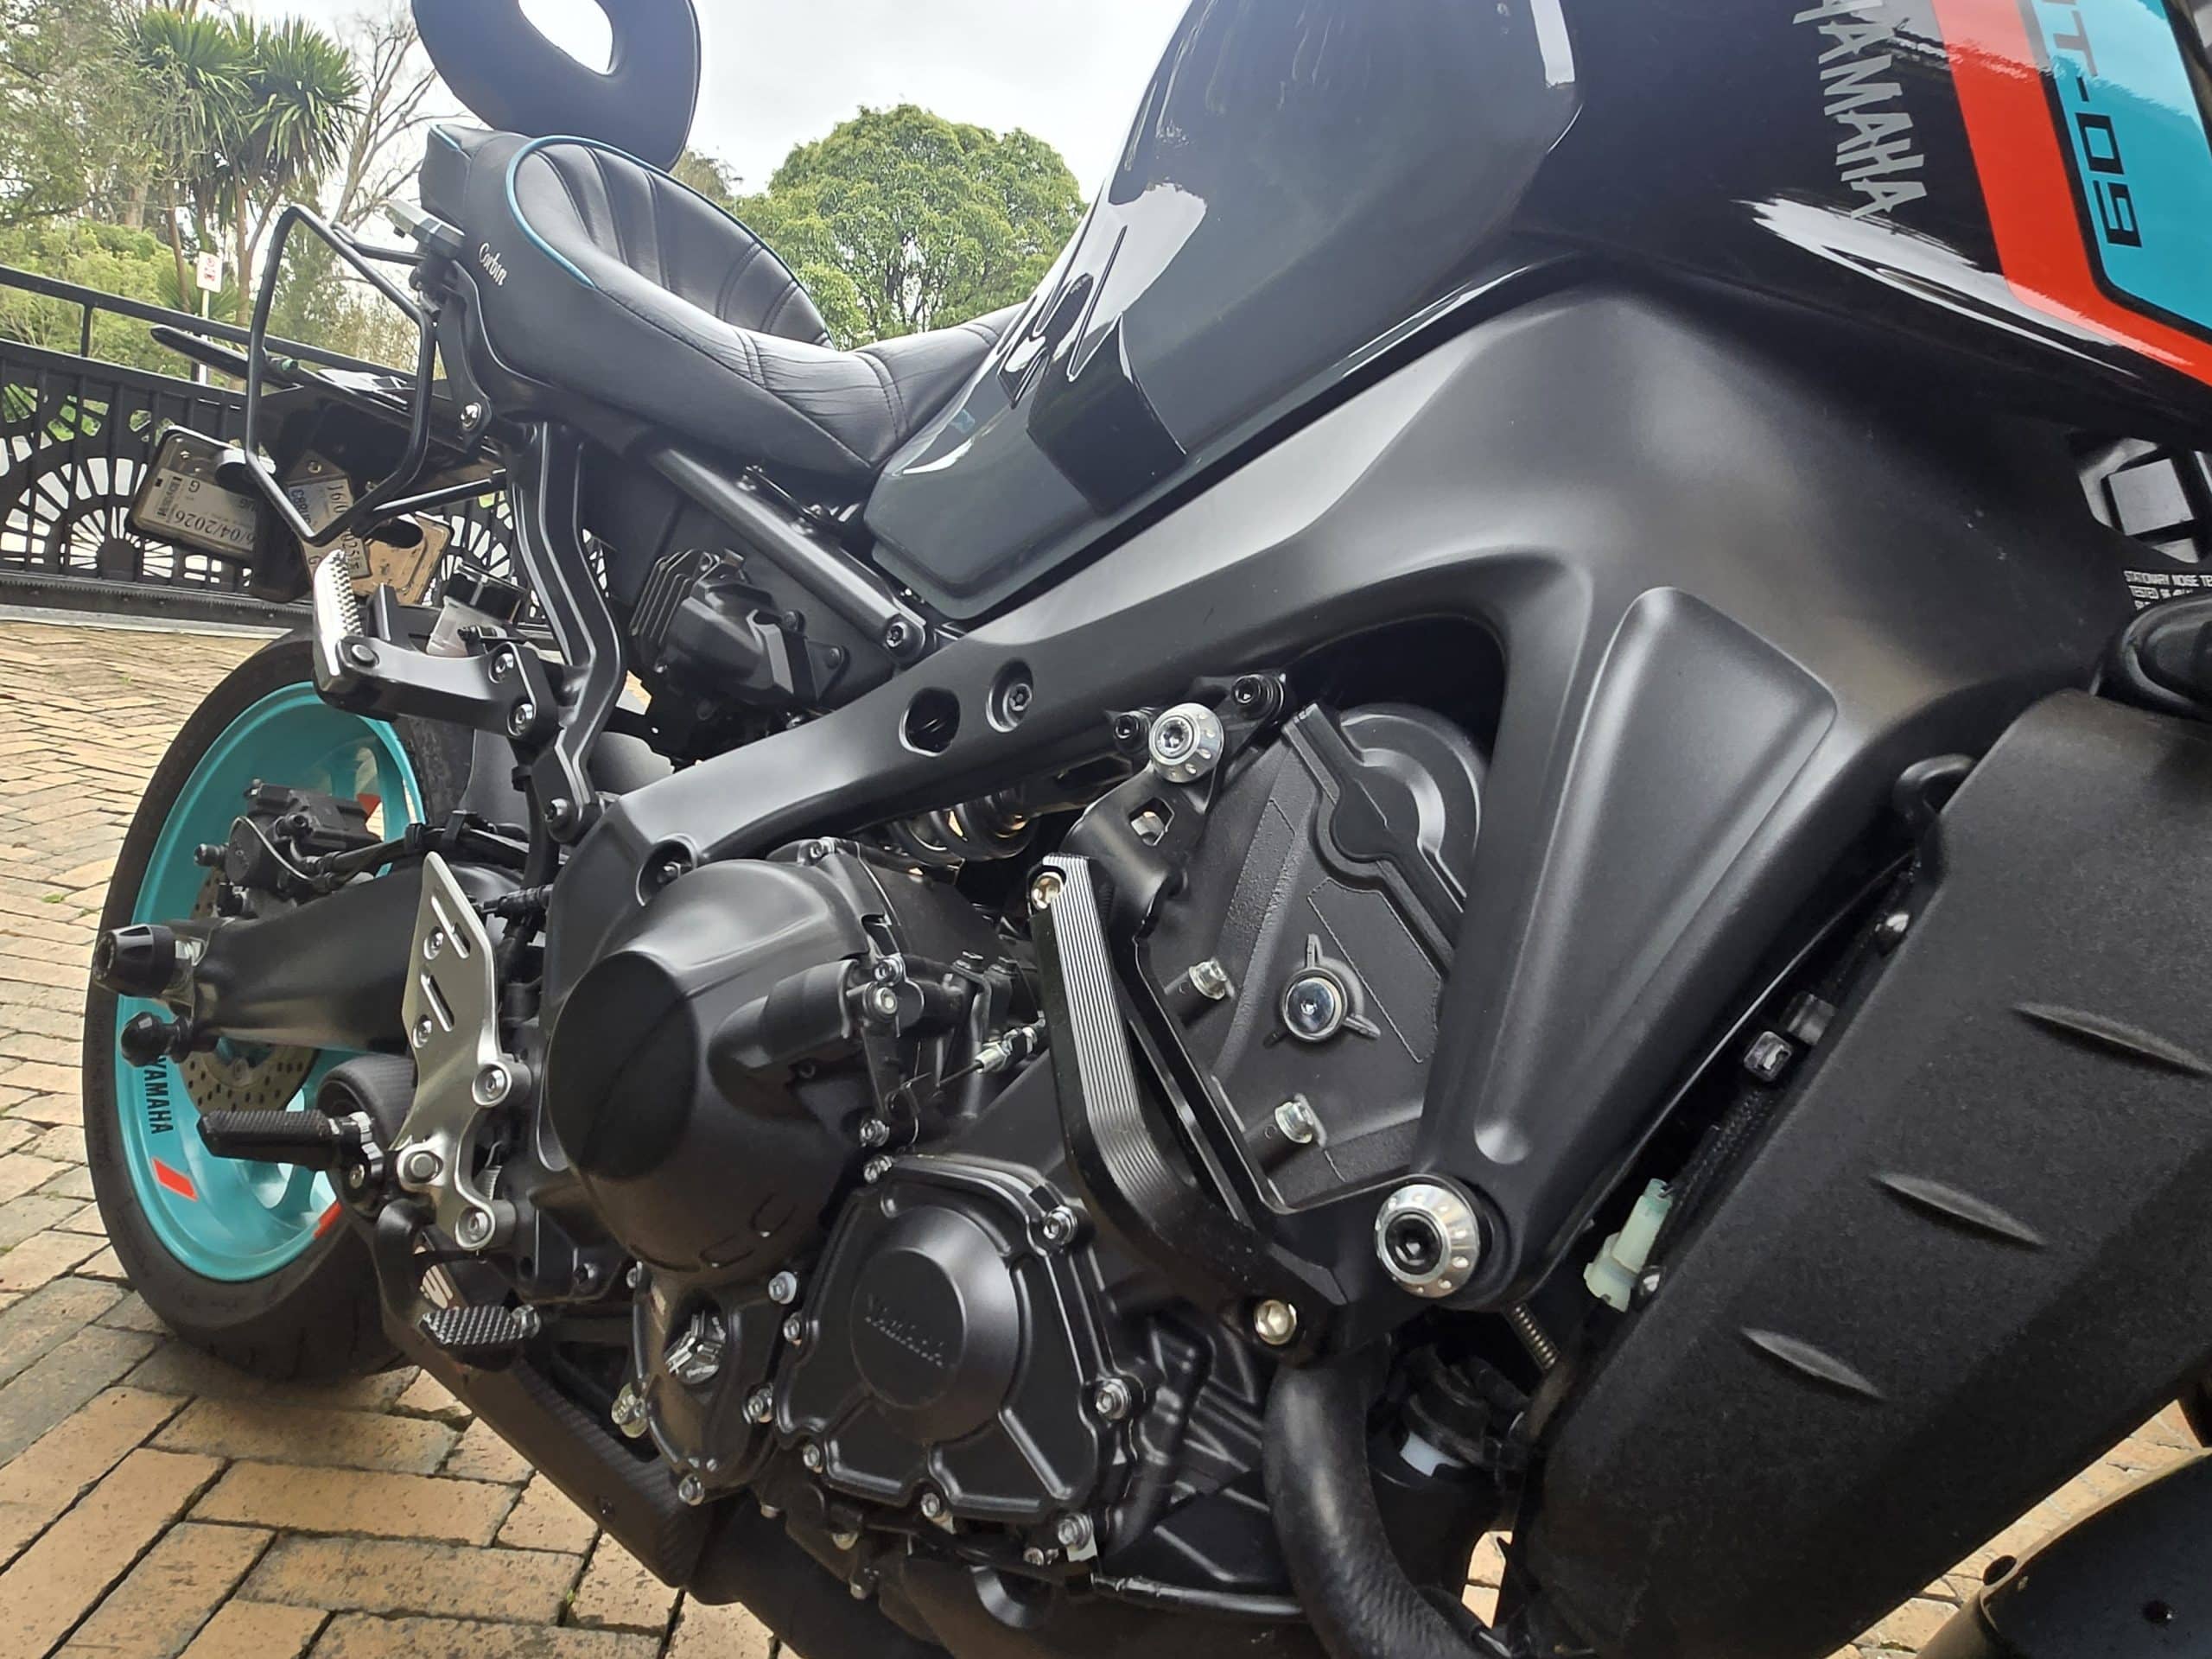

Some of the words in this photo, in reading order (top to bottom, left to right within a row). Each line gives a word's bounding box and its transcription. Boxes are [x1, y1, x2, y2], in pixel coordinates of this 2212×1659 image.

[2042, 0, 2142, 248] T-09
[479, 242, 507, 286] Corbin
[188, 480, 200, 493] G
[175, 510, 256, 545] 6/04/2026
